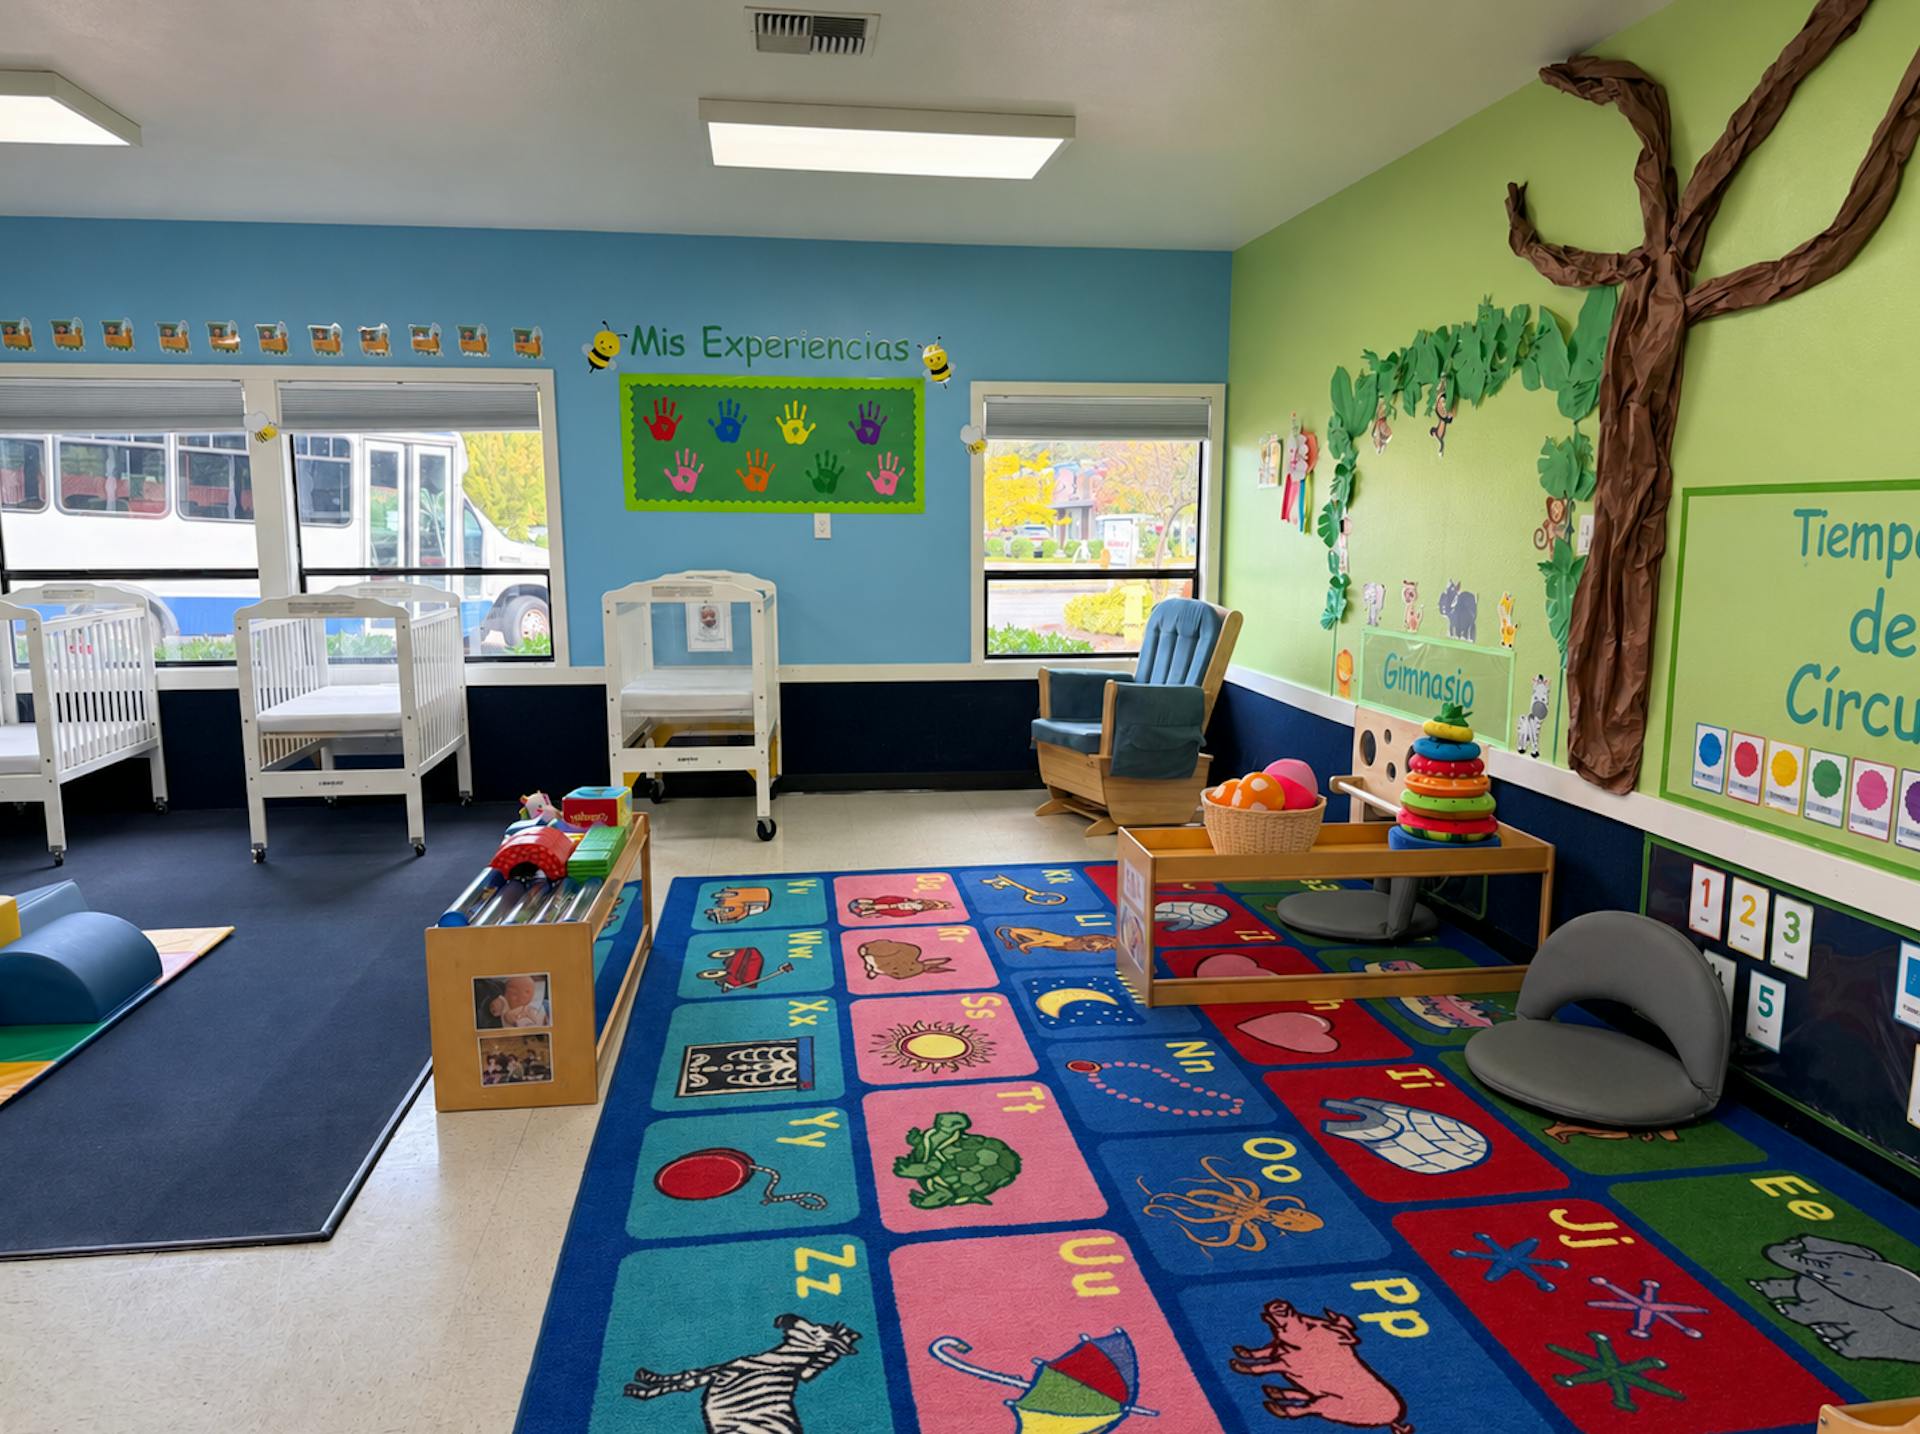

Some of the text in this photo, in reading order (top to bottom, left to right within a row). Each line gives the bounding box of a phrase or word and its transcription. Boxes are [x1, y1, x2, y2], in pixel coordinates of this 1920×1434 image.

[630, 324, 910, 368] Mis Experiencias
[1793, 508, 1920, 579] Tiemp
[1850, 587, 1917, 658] de
[1383, 652, 1475, 709] Gimnasio
[786, 879, 817, 895] Vv
[1041, 869, 1075, 884] Kk
[1701, 877, 1711, 908] 1
[1738, 894, 1756, 928] 2
[1782, 911, 1801, 944] 3
[788, 930, 823, 959] Ww
[937, 926, 972, 944] Rr
[788, 1000, 829, 1027] Xx
[960, 995, 1003, 1020] Ss
[1757, 984, 1775, 1019] 5
[1165, 1040, 1216, 1074] Nn
[1385, 1067, 1446, 1089] Ii
[996, 1086, 1045, 1115] Tt
[777, 1110, 840, 1148] Yy
[1243, 1137, 1302, 1183] Oo
[1750, 1175, 1834, 1221] Ee
[1548, 1209, 1635, 1248] Jj
[795, 1243, 856, 1298] Zz
[1059, 1236, 1126, 1298] Uu
[1350, 1277, 1430, 1338] Pp
